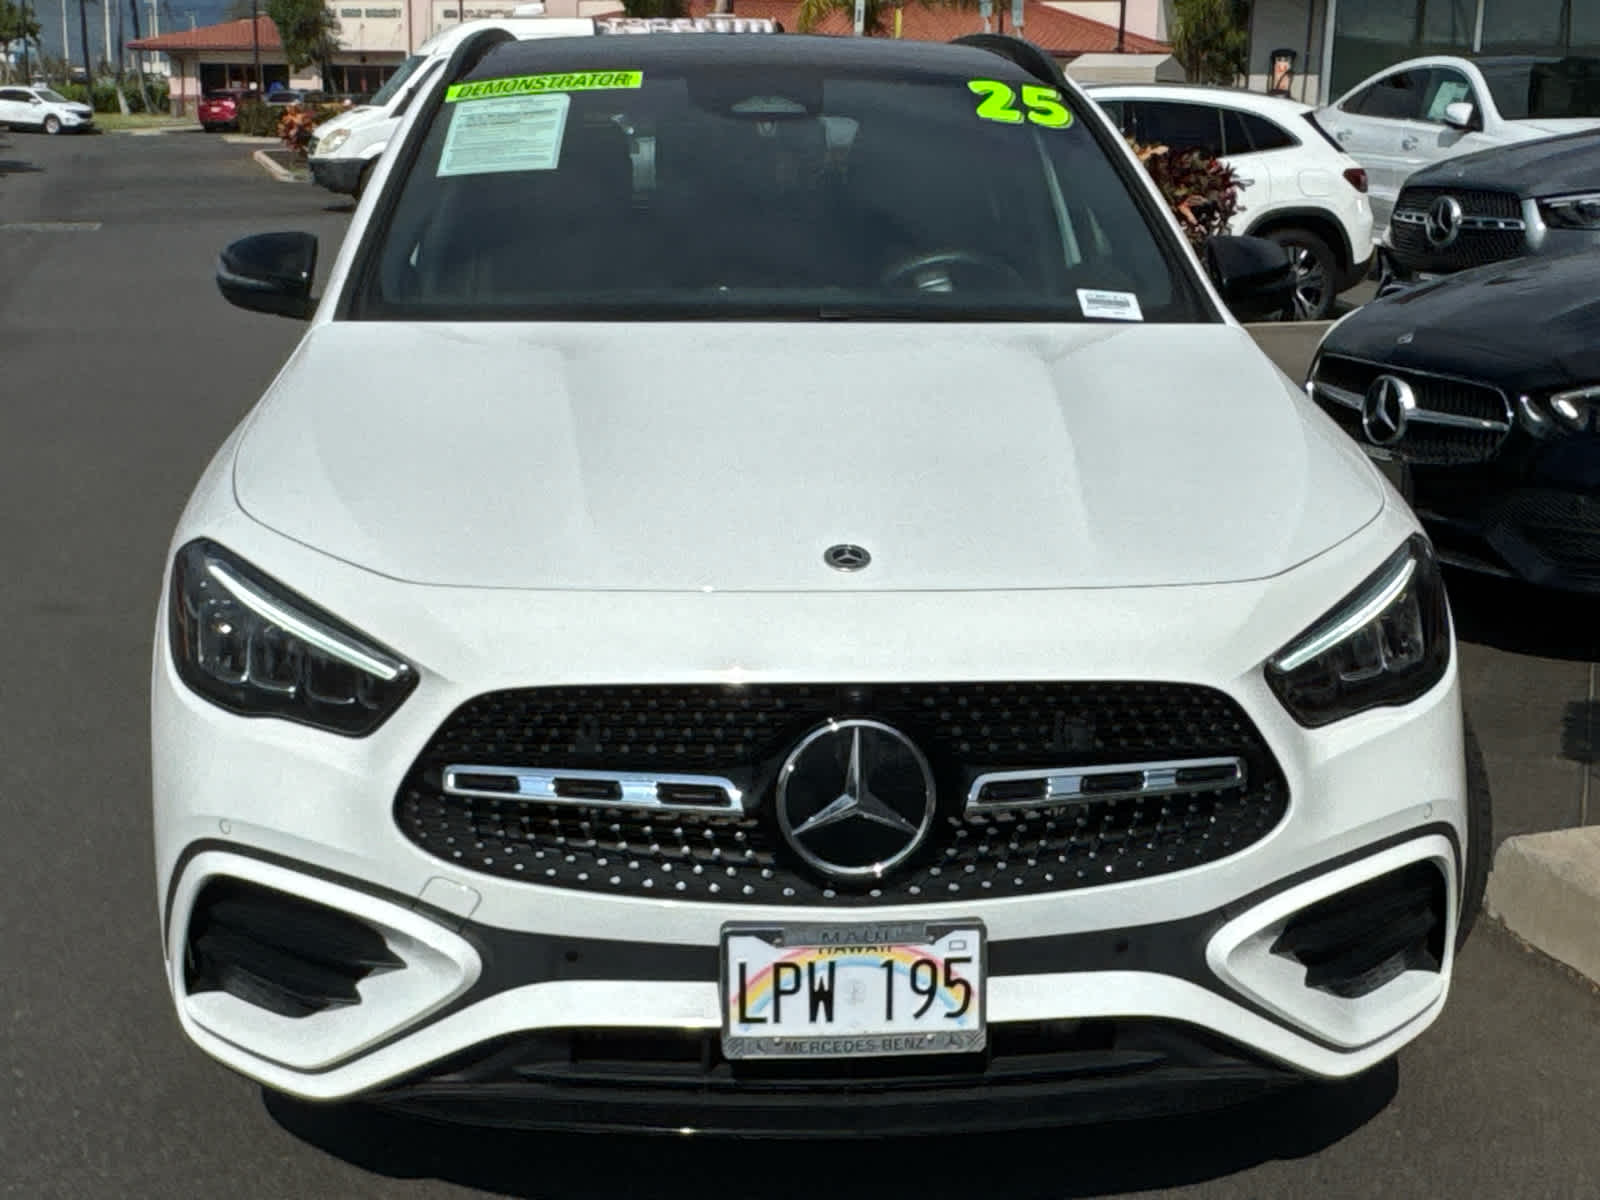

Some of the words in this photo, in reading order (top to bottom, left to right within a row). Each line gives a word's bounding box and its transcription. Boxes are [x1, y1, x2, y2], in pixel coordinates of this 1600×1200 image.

[967, 79, 1074, 129] 25
[821, 929, 888, 942] MAUI
[738, 961, 836, 1024] LPW
[880, 957, 972, 1021] 195
